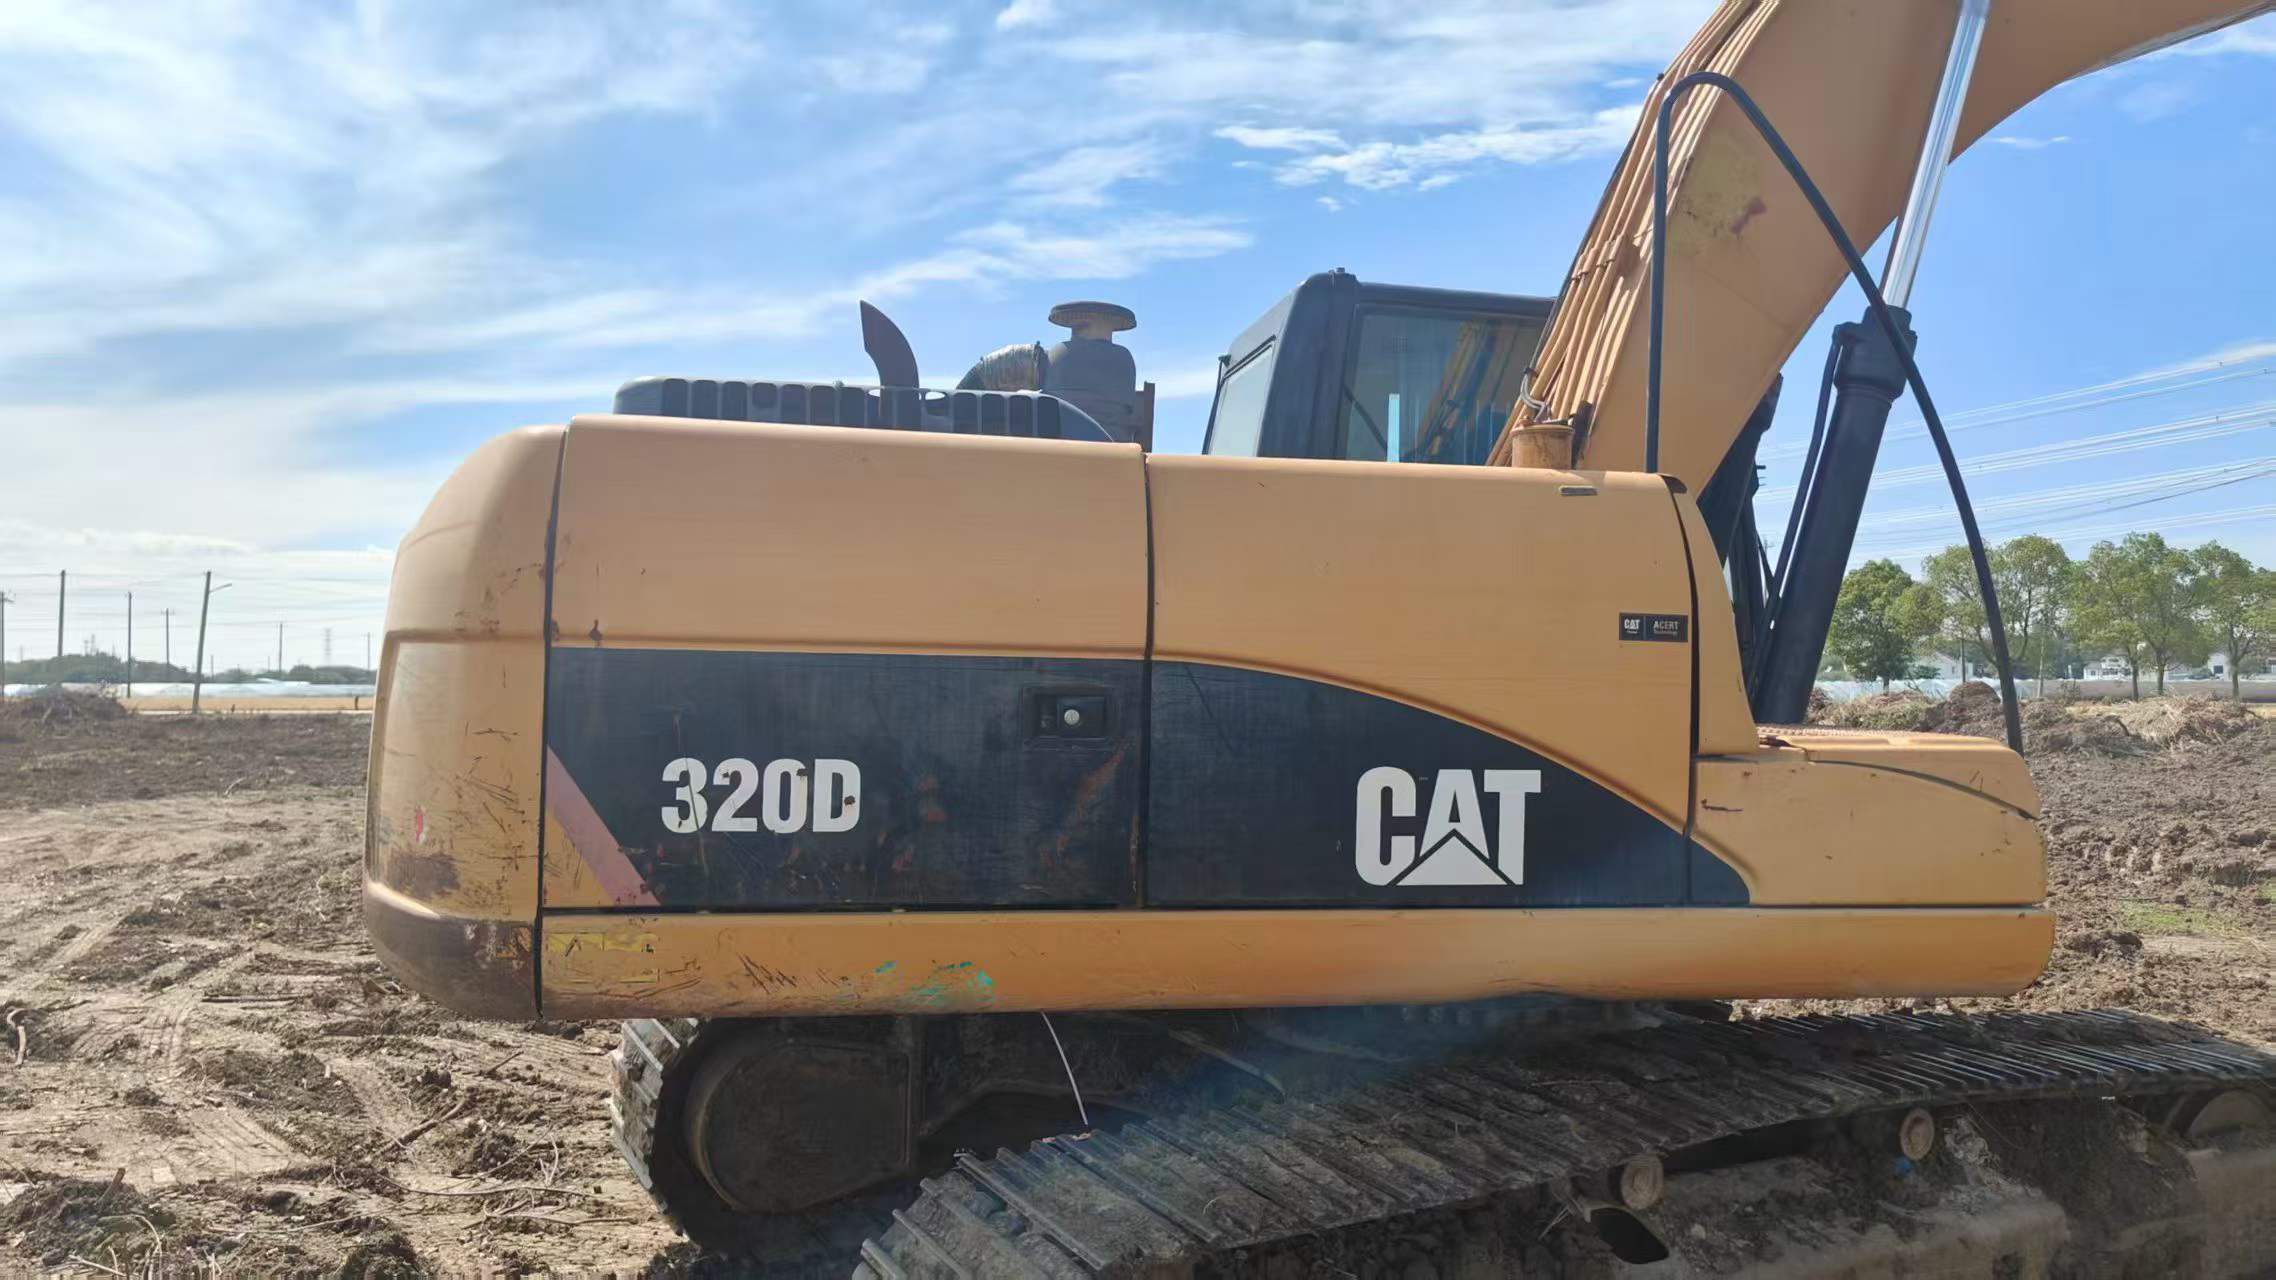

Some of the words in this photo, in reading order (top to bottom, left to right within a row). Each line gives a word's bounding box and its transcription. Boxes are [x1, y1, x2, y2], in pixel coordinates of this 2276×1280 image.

[1624, 618, 1640, 629] CAT
[1653, 621, 1679, 630] ACERT
[661, 757, 861, 834] 320D
[1355, 766, 1542, 886] CAT
